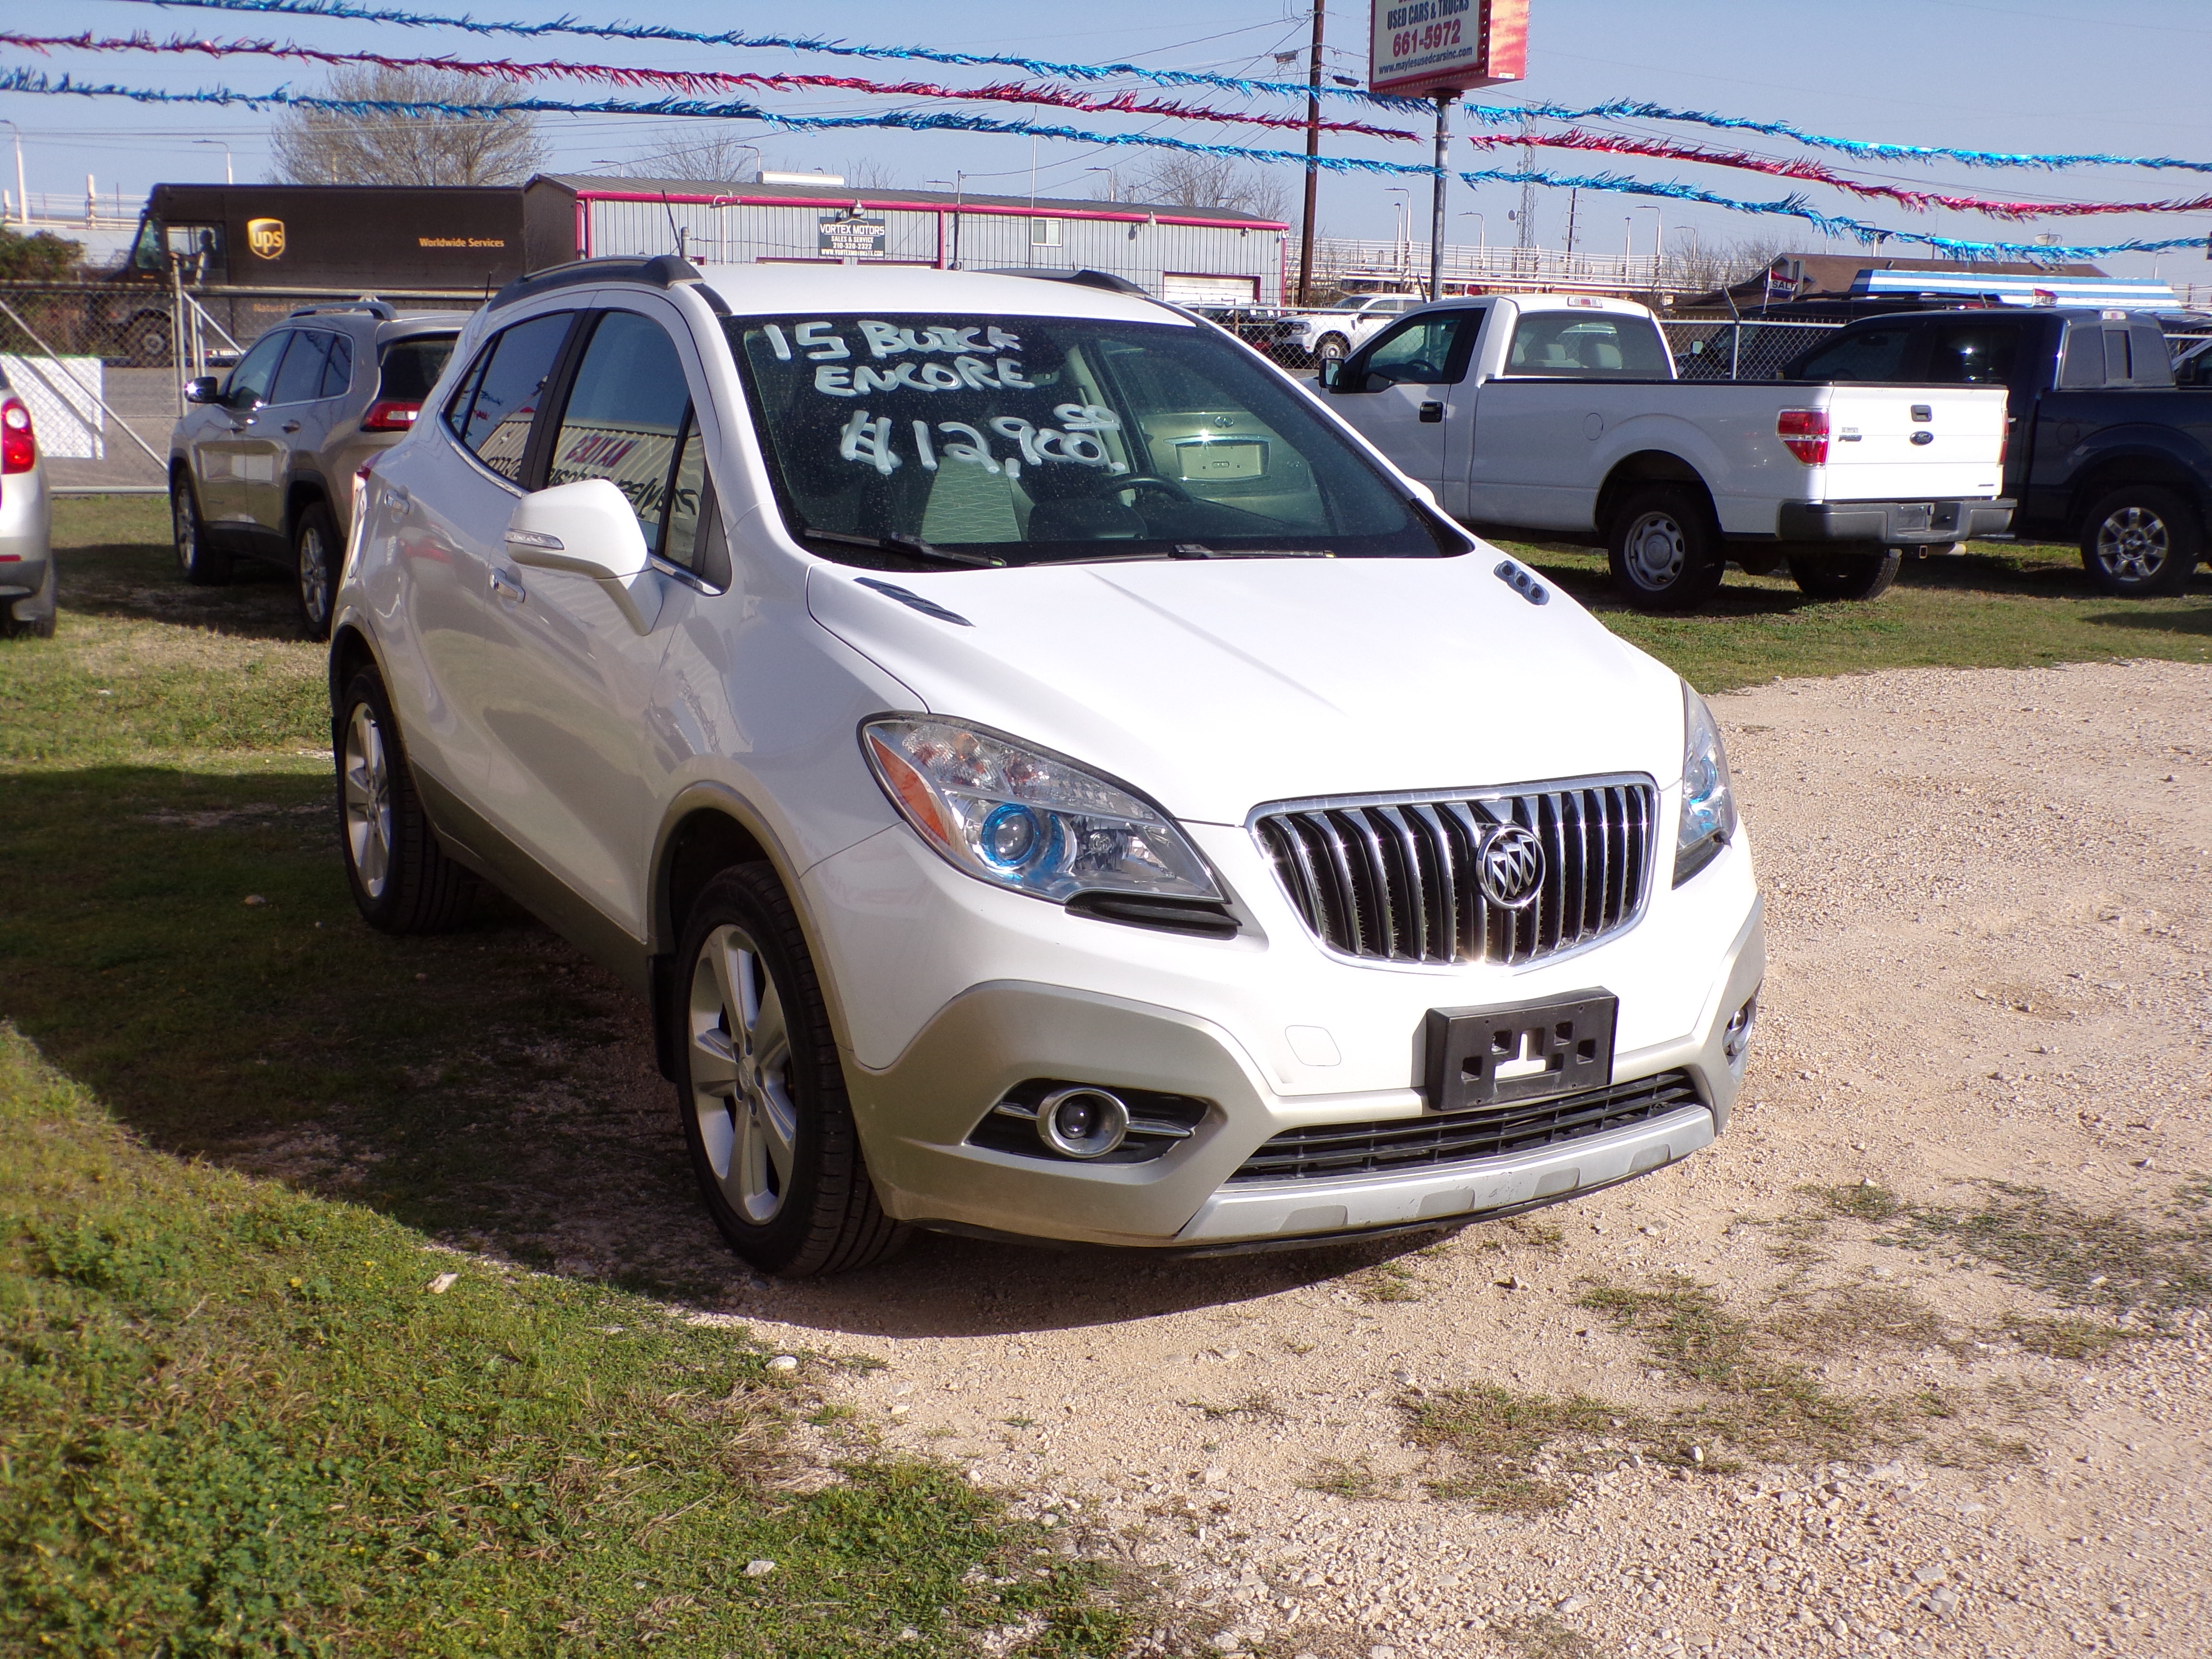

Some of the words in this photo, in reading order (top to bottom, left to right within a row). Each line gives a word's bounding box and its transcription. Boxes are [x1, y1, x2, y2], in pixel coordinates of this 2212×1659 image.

[1387, 8, 1407, 30] USED
[1408, 1, 1429, 25] CARS
[1431, 2, 1436, 20] &
[1438, 0, 1469, 17] TRUCKS
[1393, 18, 1461, 57] 661-5972
[253, 231, 283, 253] ups
[419, 238, 466, 247] Worldwide
[468, 238, 504, 247] Services
[820, 224, 851, 234] VORTEX
[853, 225, 885, 235] MOTORS
[2035, 297, 2056, 305] SALE
[763, 321, 851, 361] 15
[814, 356, 1035, 397] ENCORE
